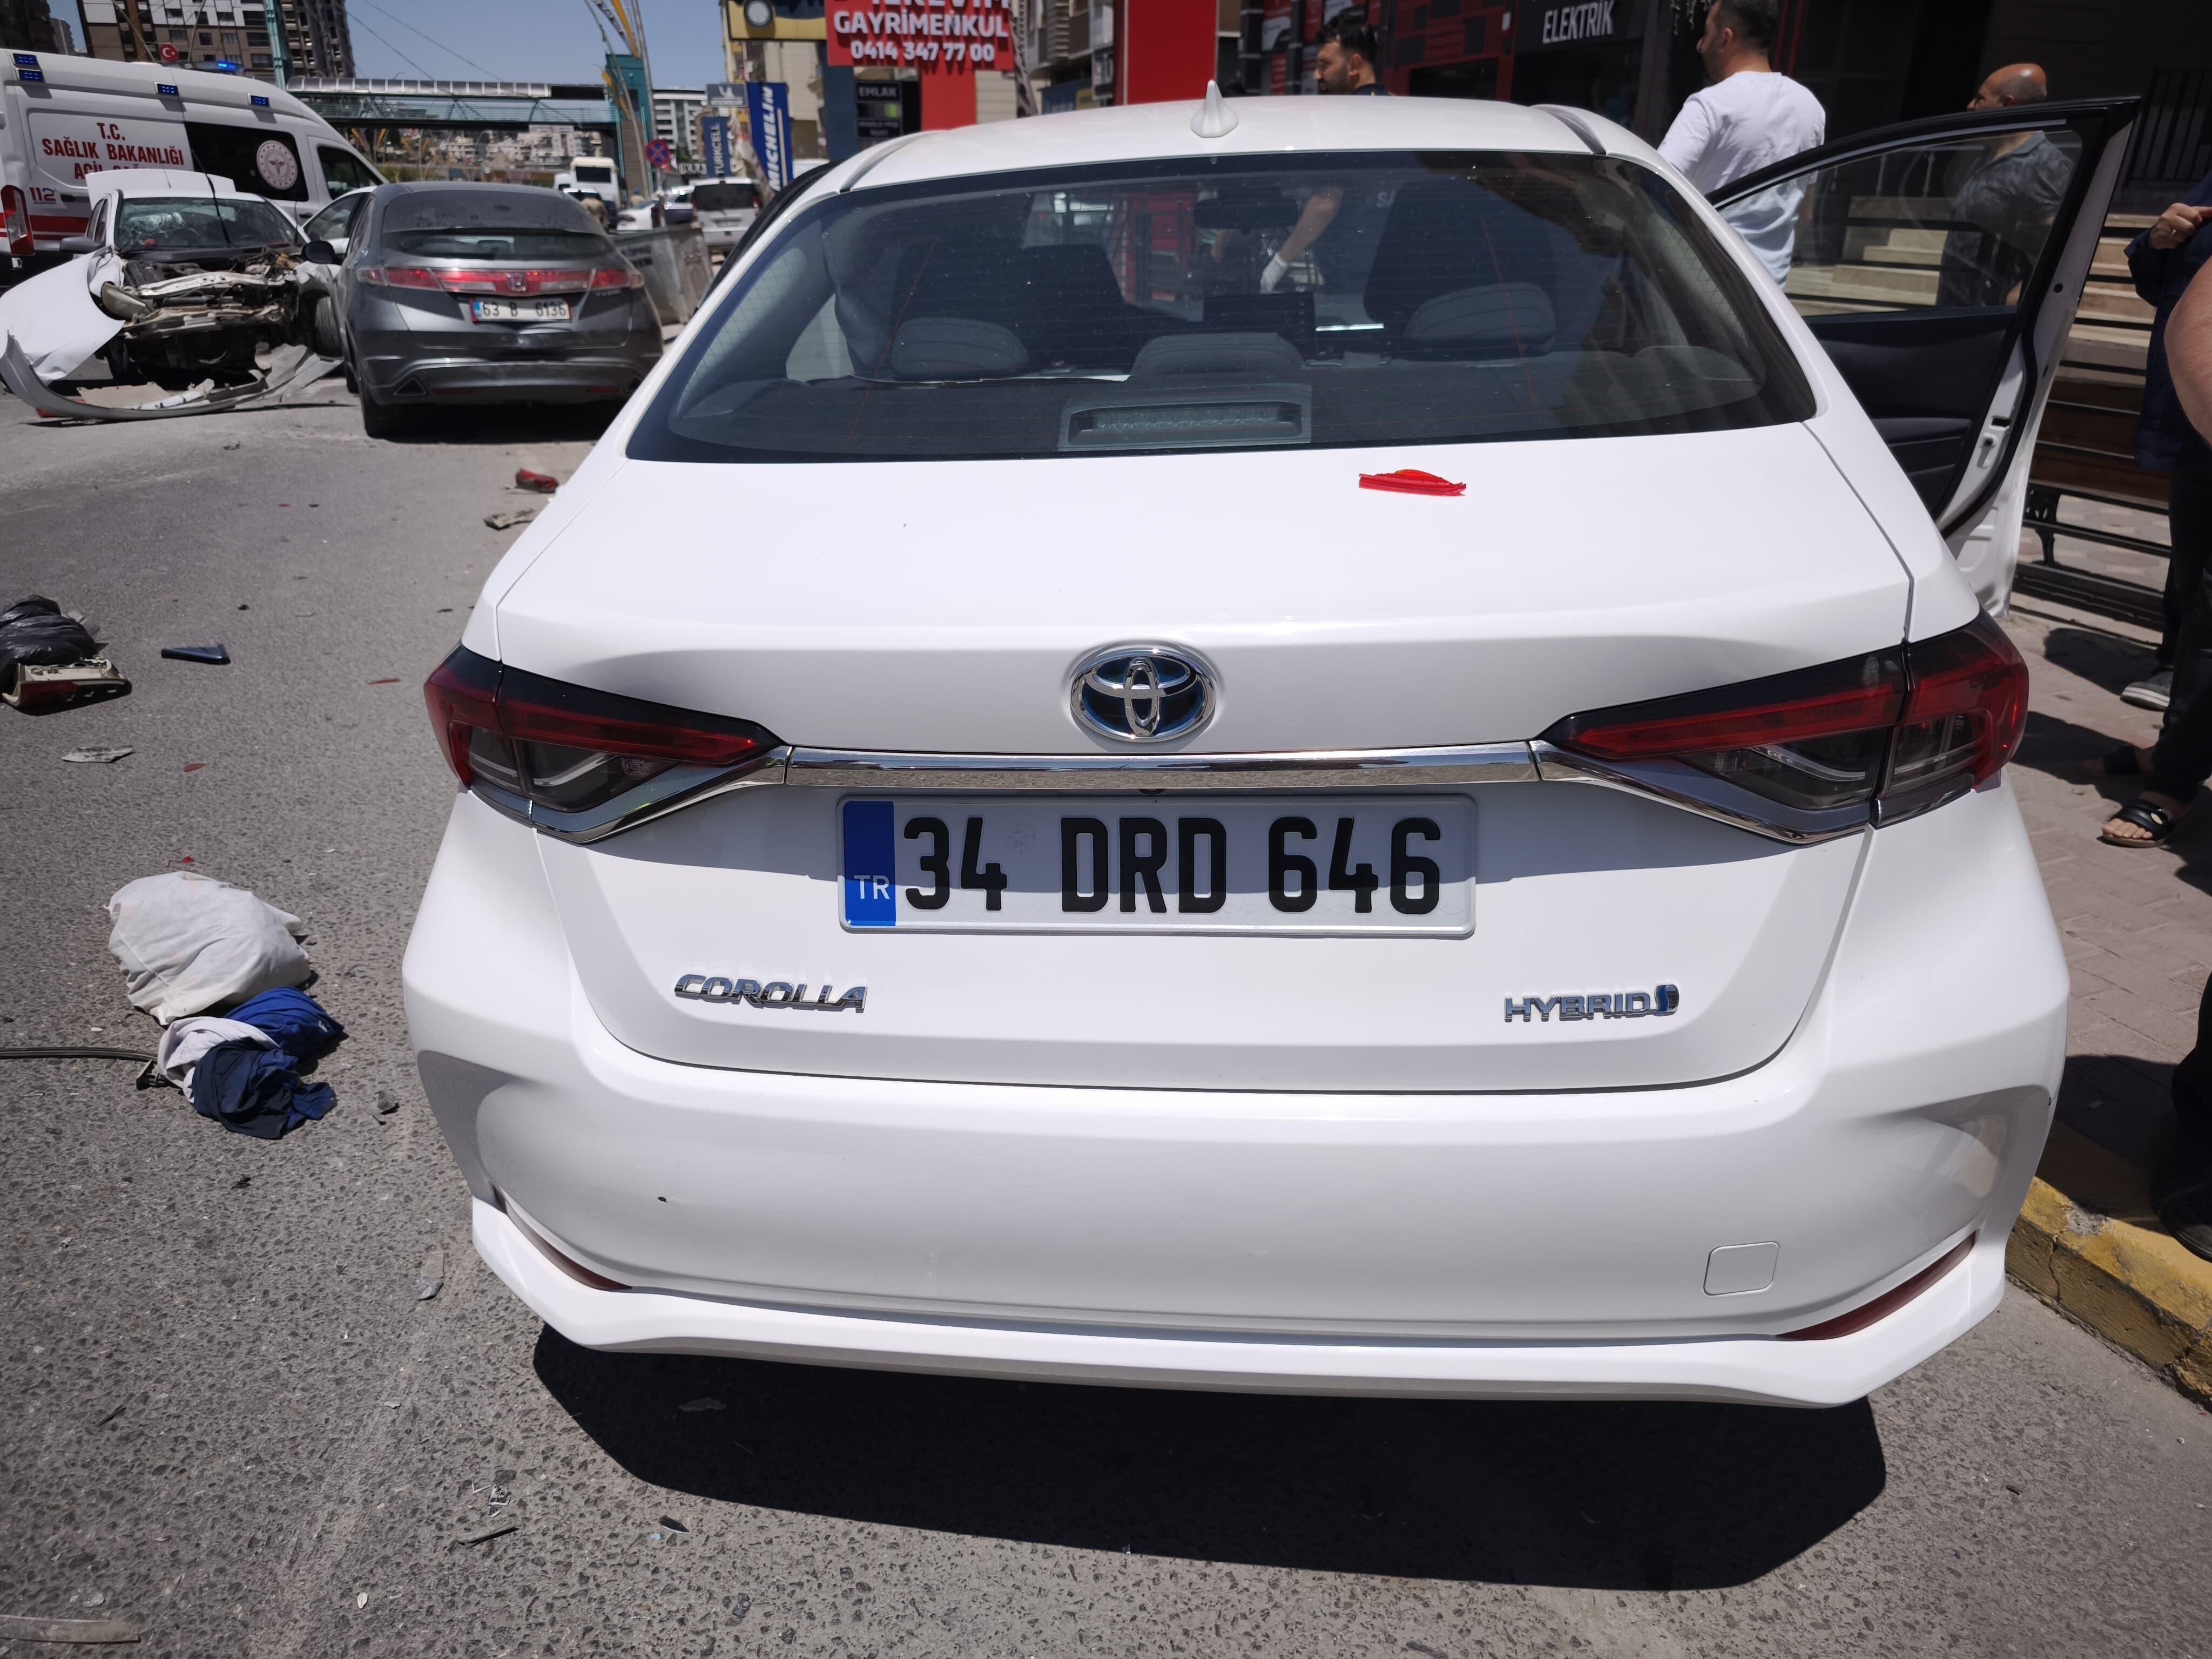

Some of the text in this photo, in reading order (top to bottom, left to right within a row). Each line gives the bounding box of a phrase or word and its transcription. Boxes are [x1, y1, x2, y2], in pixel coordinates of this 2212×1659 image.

[833, 9, 1009, 37] GAYRİMENKUL
[1542, 0, 1615, 44] ELEKTRİK
[850, 40, 995, 62] 0414 347 77 00
[97, 122, 125, 141] T.C.
[762, 86, 781, 192] MICHELIN
[42, 136, 185, 166] SAĞLIK BAKANLIĞI
[29, 187, 56, 201] 112
[483, 302, 500, 316] 63
[509, 301, 518, 316] B
[535, 302, 567, 317] 6136
[853, 816, 1441, 915] TR 34 DRD 646
[674, 974, 868, 1014] COROLLA
[1505, 992, 1651, 1022] HYBRID
